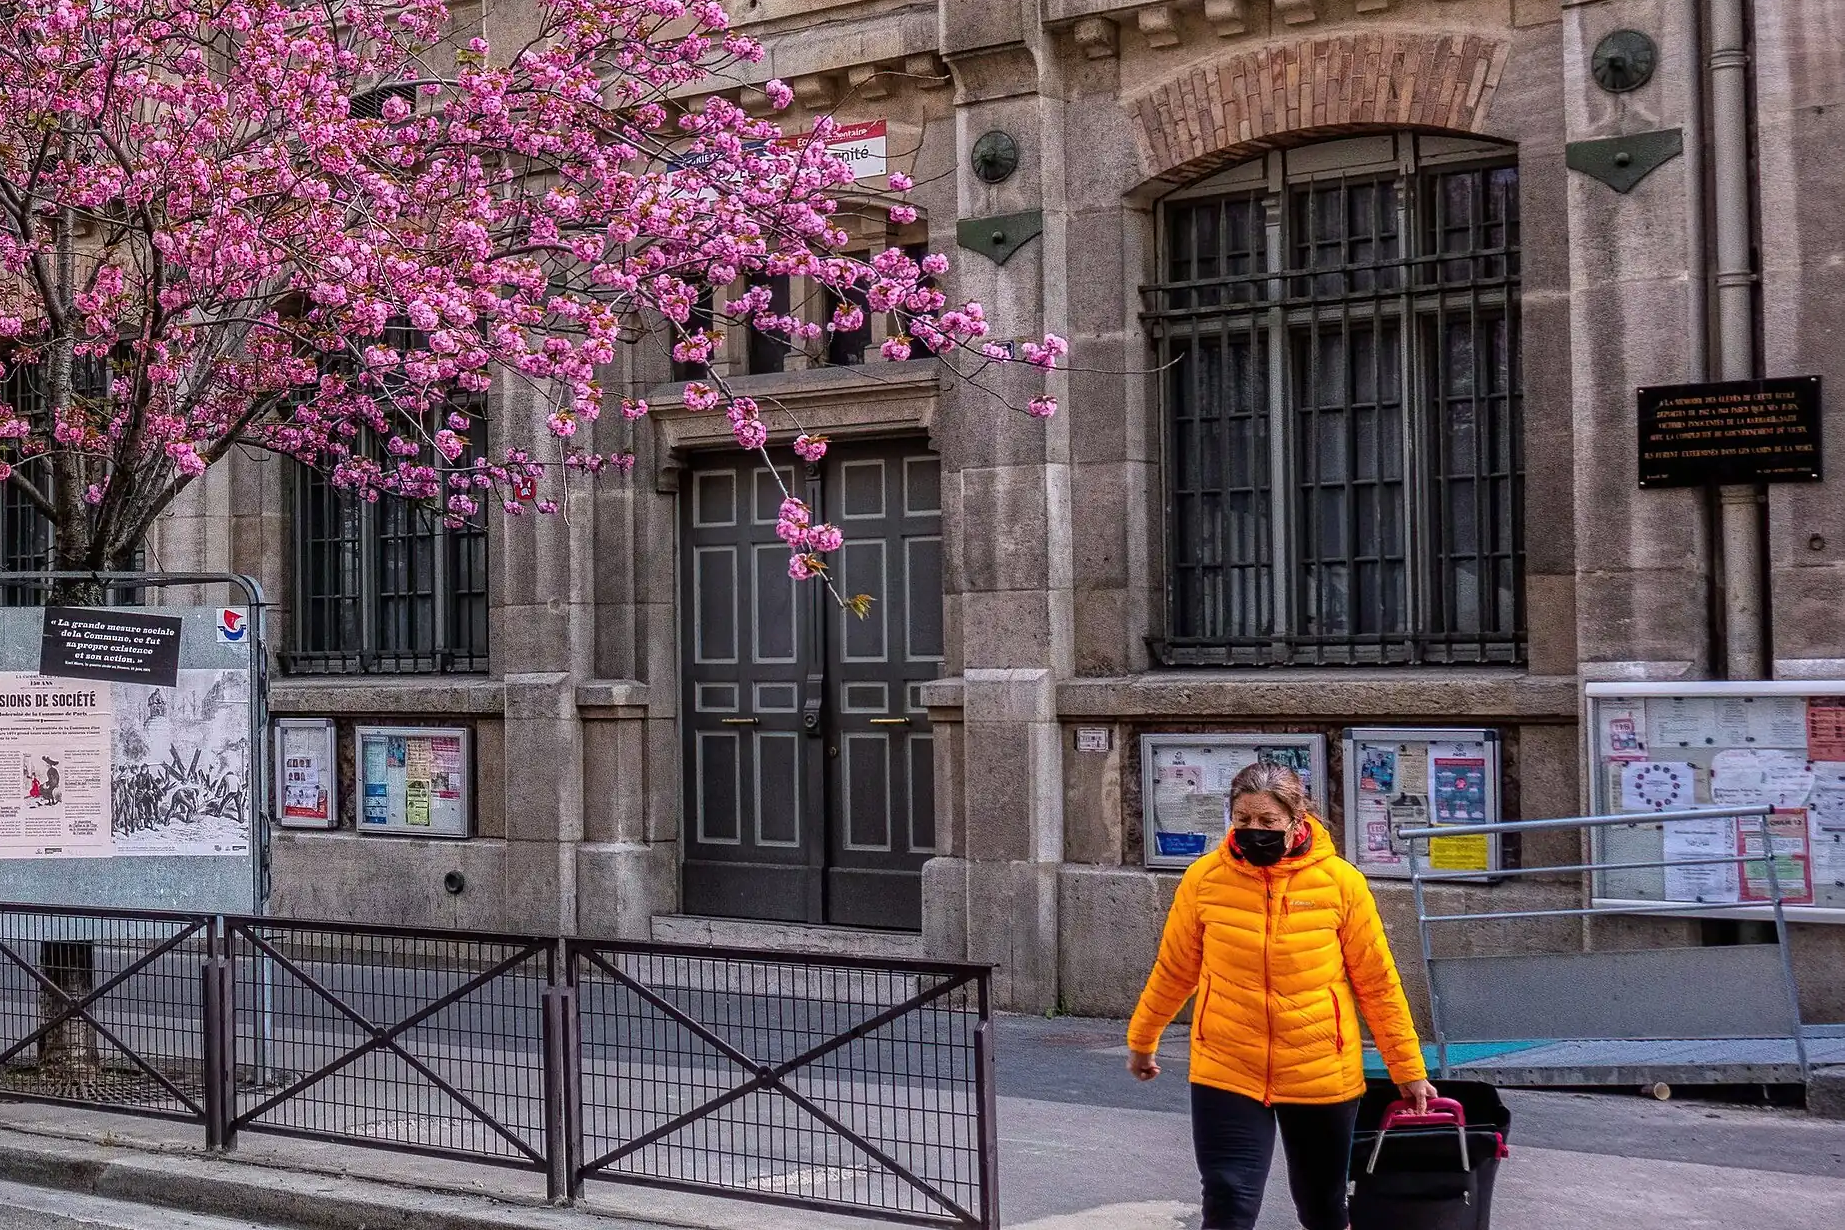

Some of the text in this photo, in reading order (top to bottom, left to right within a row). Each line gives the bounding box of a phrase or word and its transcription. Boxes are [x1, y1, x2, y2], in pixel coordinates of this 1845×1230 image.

[58, 619, 69, 627] La
[71, 621, 105, 630] grande
[107, 624, 141, 632] mesure
[143, 627, 175, 636] sociale
[145, 637, 161, 645] fut
[110, 645, 153, 654] existence
[35, 694, 49, 707] DE
[52, 691, 96, 707] SOCIÉTÉ
